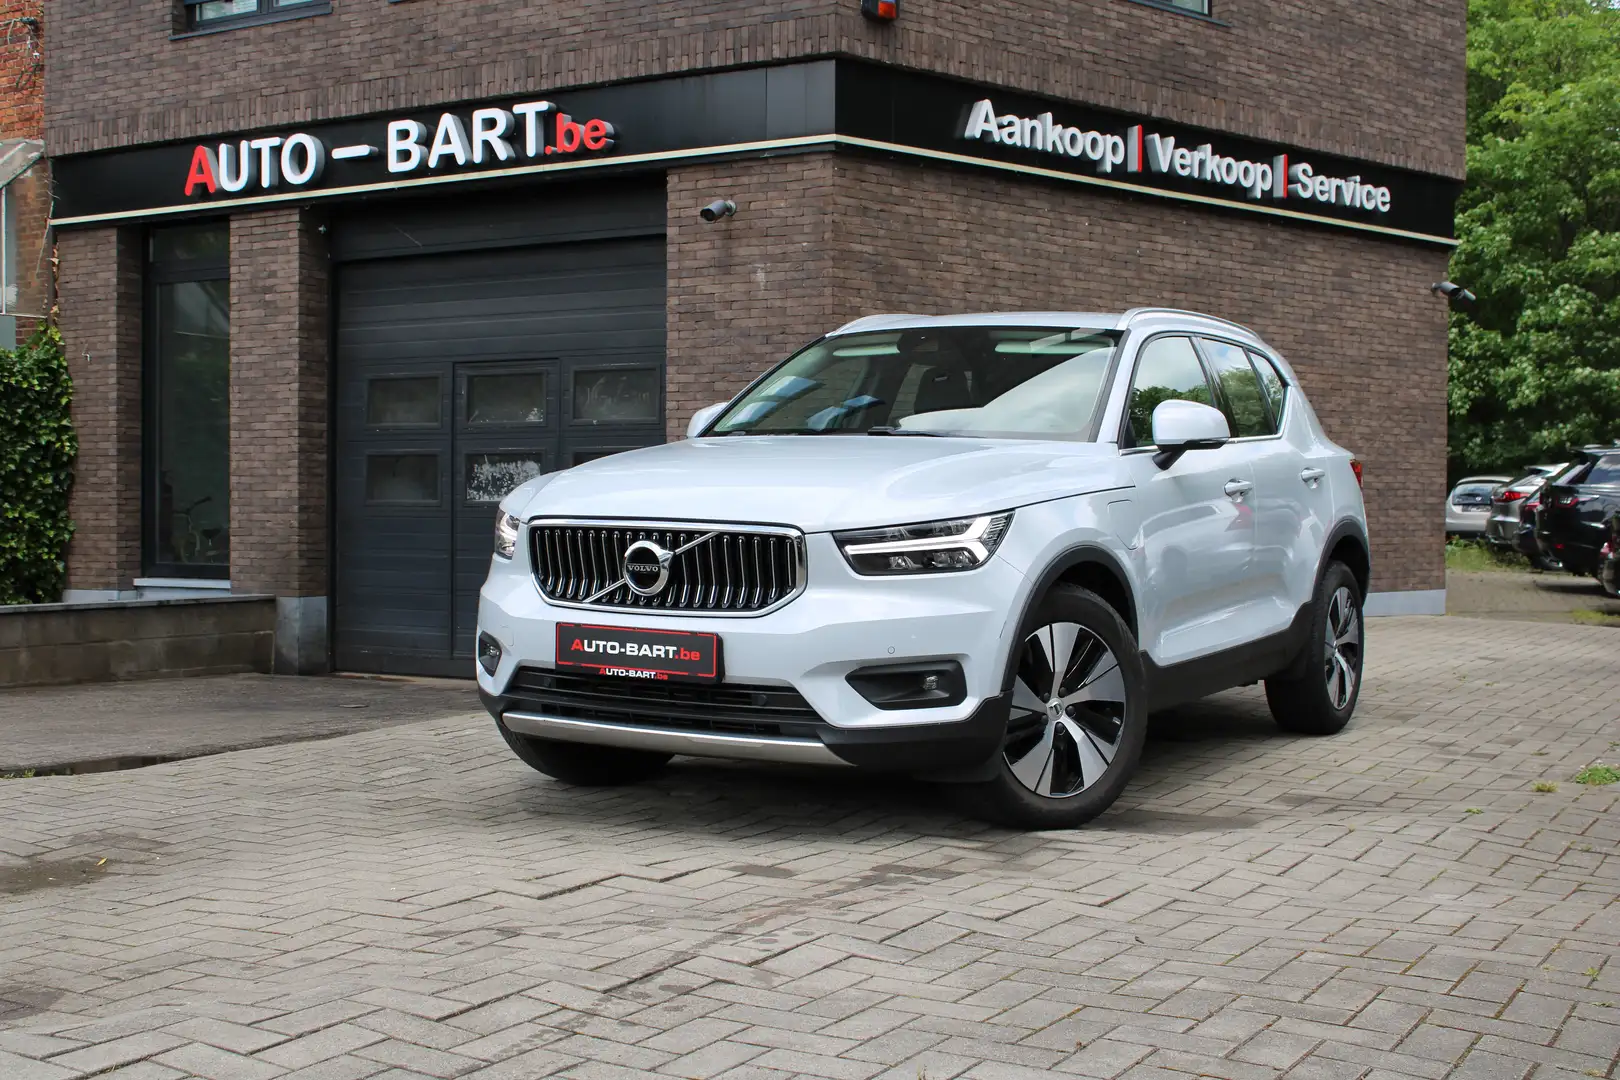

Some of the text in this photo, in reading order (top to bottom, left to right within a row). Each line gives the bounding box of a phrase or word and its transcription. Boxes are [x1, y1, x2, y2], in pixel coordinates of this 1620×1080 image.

[184, 132, 324, 197] AUTO
[387, 100, 616, 174] BART.be
[964, 99, 1392, 213] Aankoop Verkoop Service
[627, 564, 659, 572] VOLVO
[571, 638, 701, 662] AUTO-BART.be
[599, 667, 669, 681] AUTO-BART.be
